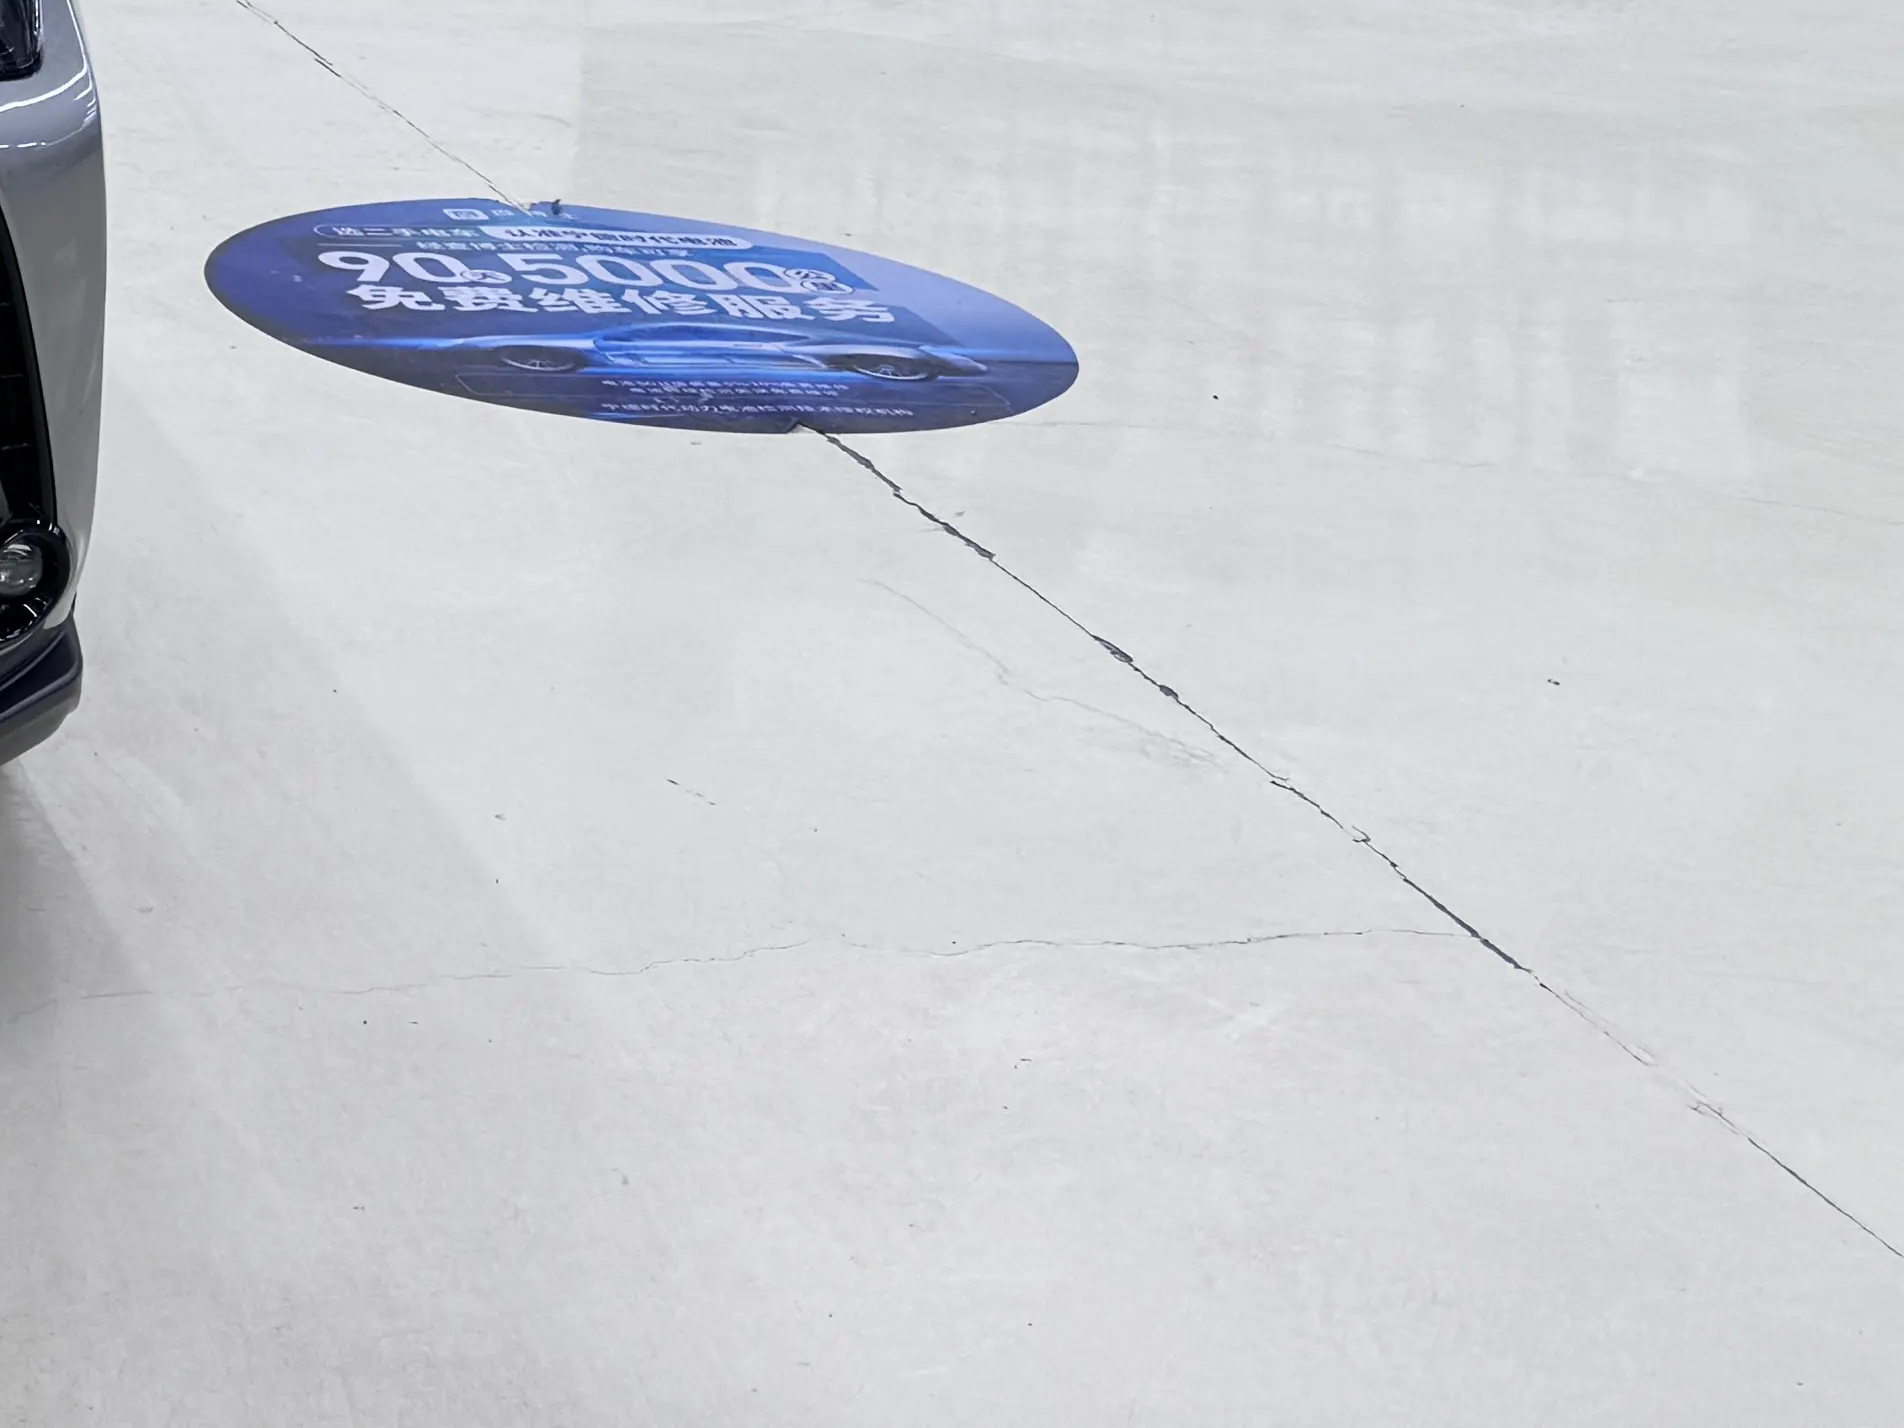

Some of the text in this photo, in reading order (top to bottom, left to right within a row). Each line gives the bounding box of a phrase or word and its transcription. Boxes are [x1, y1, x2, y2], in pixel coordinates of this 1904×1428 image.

[347, 284, 896, 323] 免费维修服务
